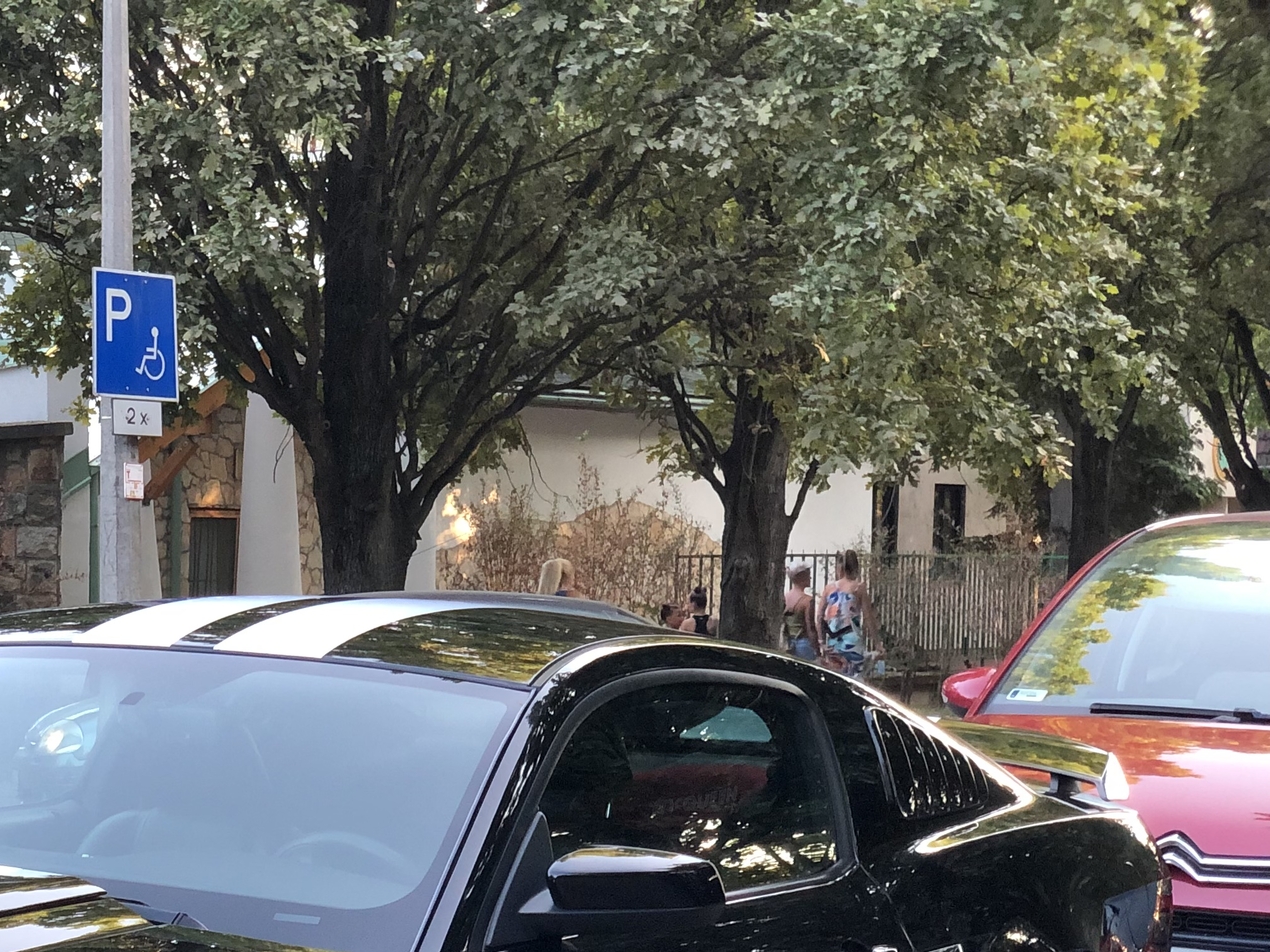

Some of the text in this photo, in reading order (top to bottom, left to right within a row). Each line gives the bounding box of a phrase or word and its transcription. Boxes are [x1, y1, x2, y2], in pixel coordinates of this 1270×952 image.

[106, 288, 132, 342] P
[127, 407, 148, 426] 2 x
